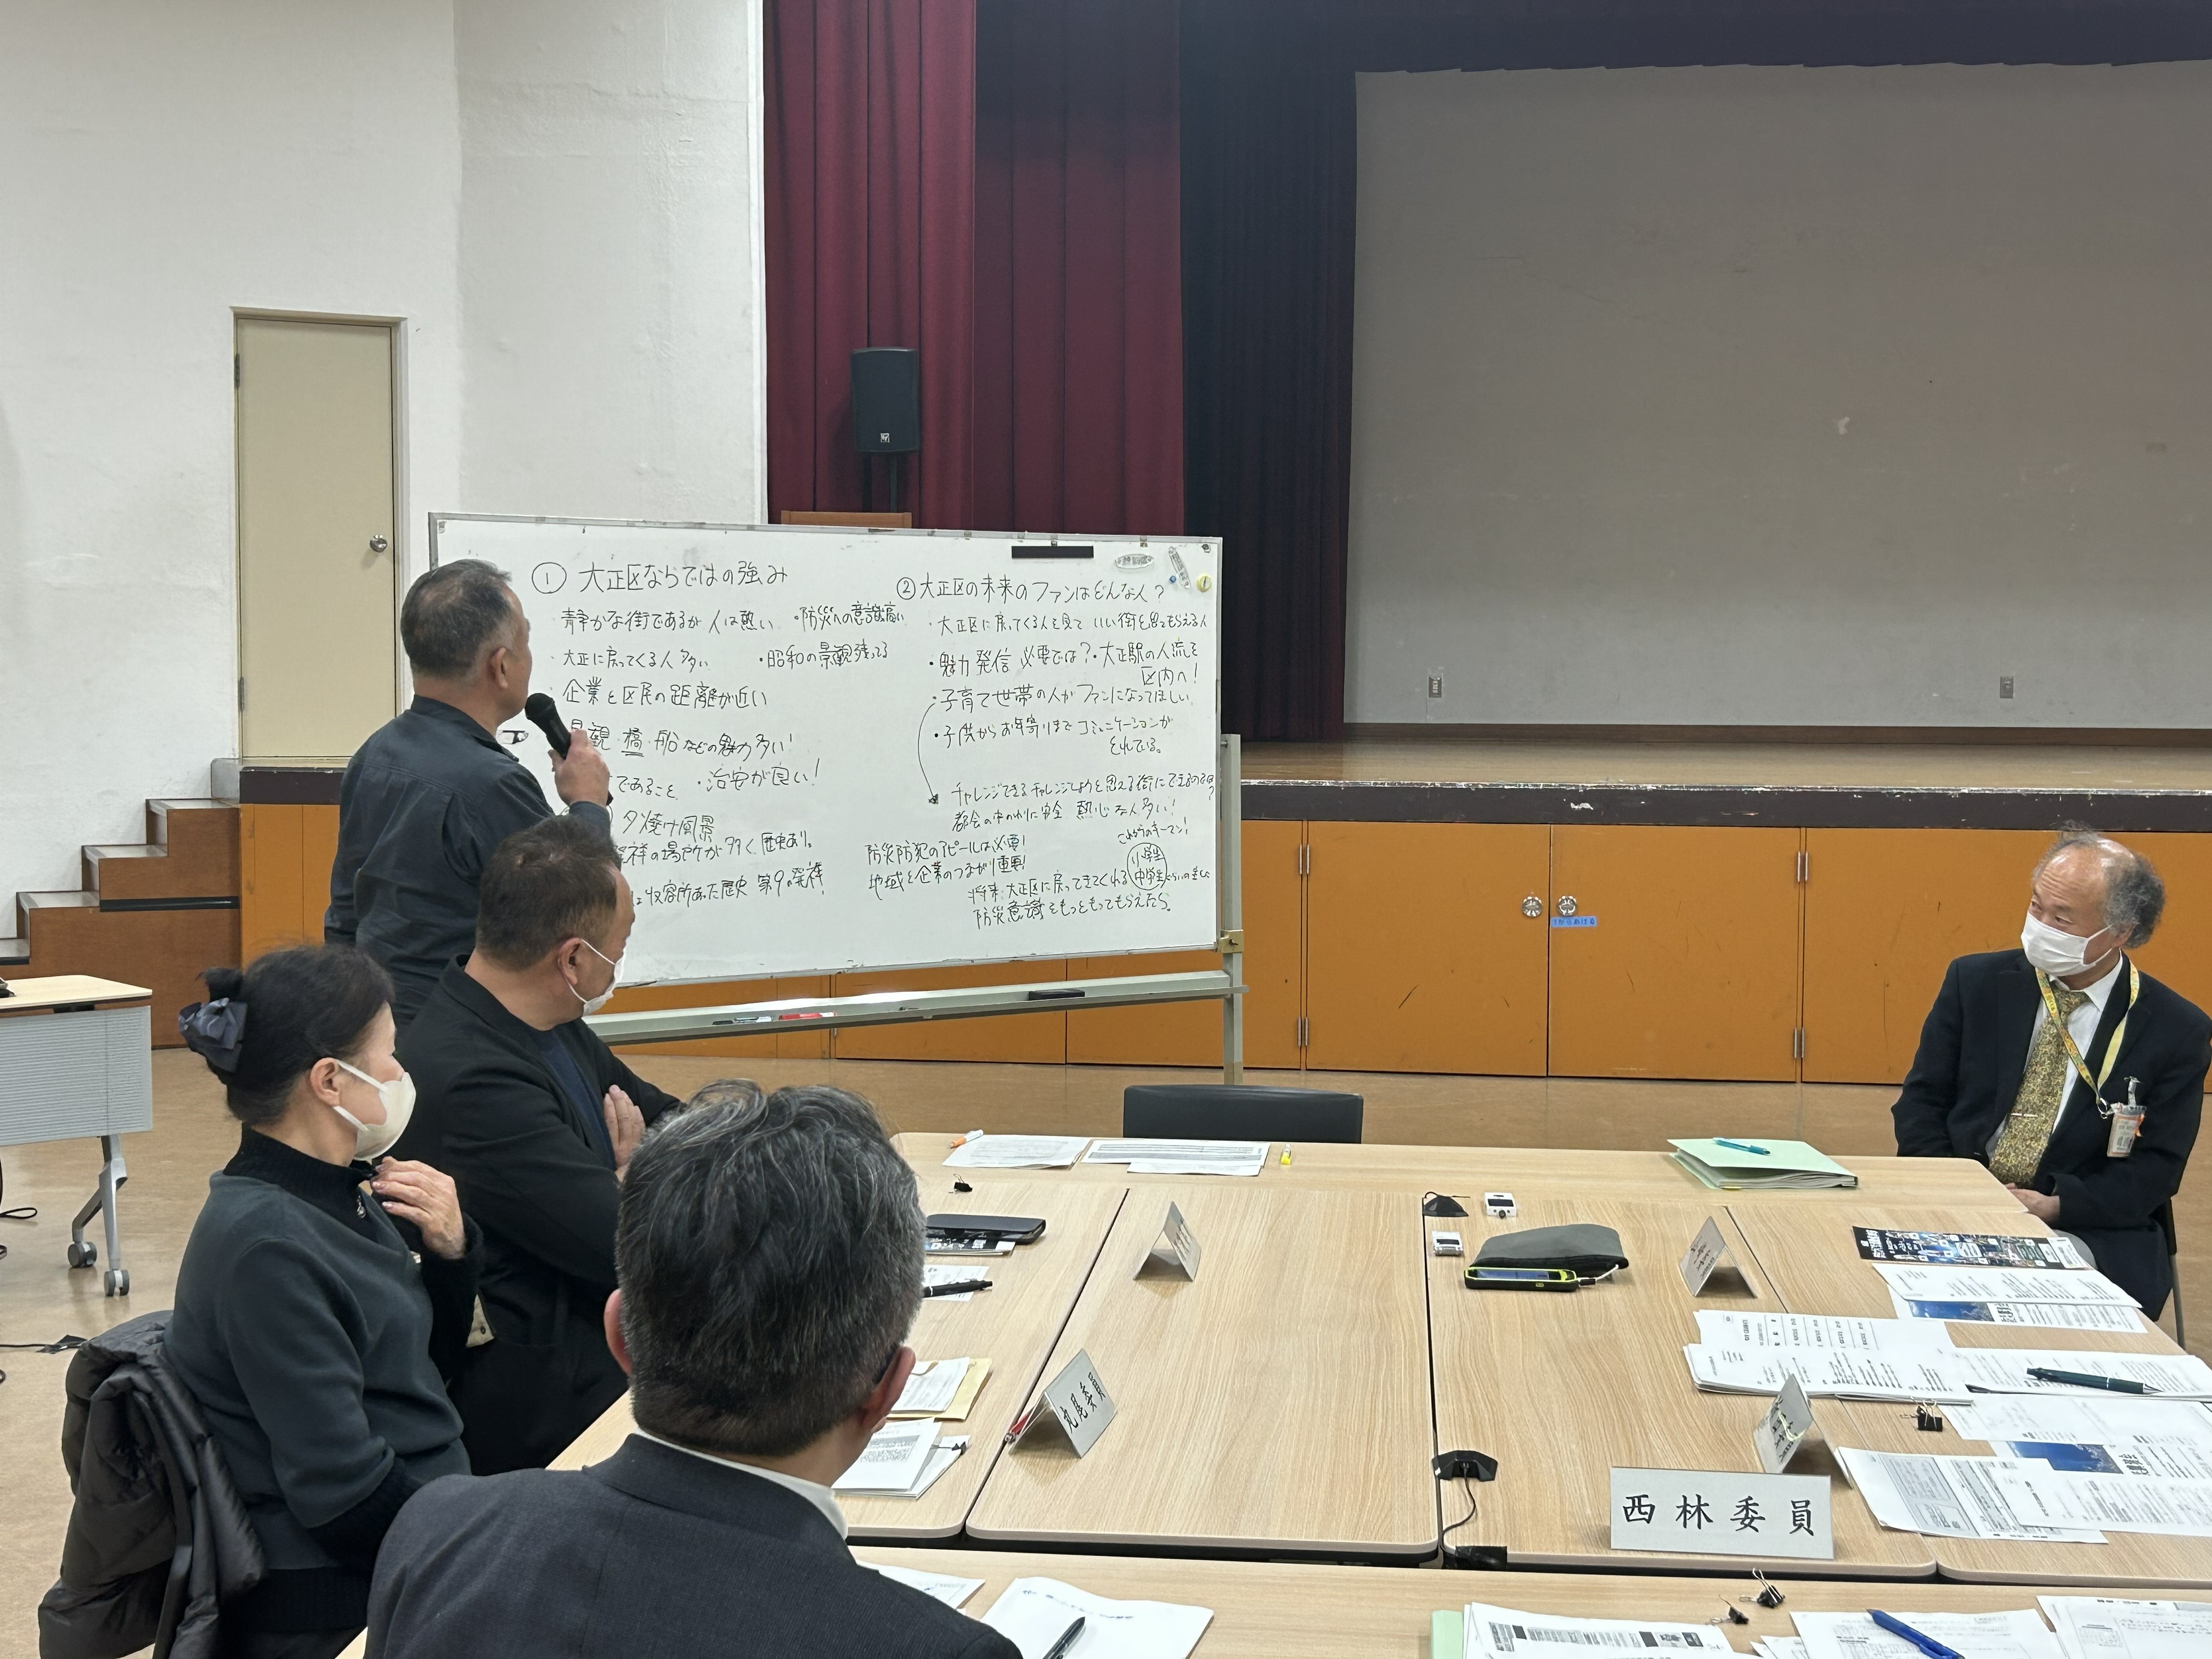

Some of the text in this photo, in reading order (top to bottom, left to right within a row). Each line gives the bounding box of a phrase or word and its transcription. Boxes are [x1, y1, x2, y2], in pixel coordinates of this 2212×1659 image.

[579, 561, 788, 592] 大正区ならではの強み
[563, 676, 768, 709] 企業と区民の距離が近い
[1622, 1494, 1815, 1537] 西林委員
